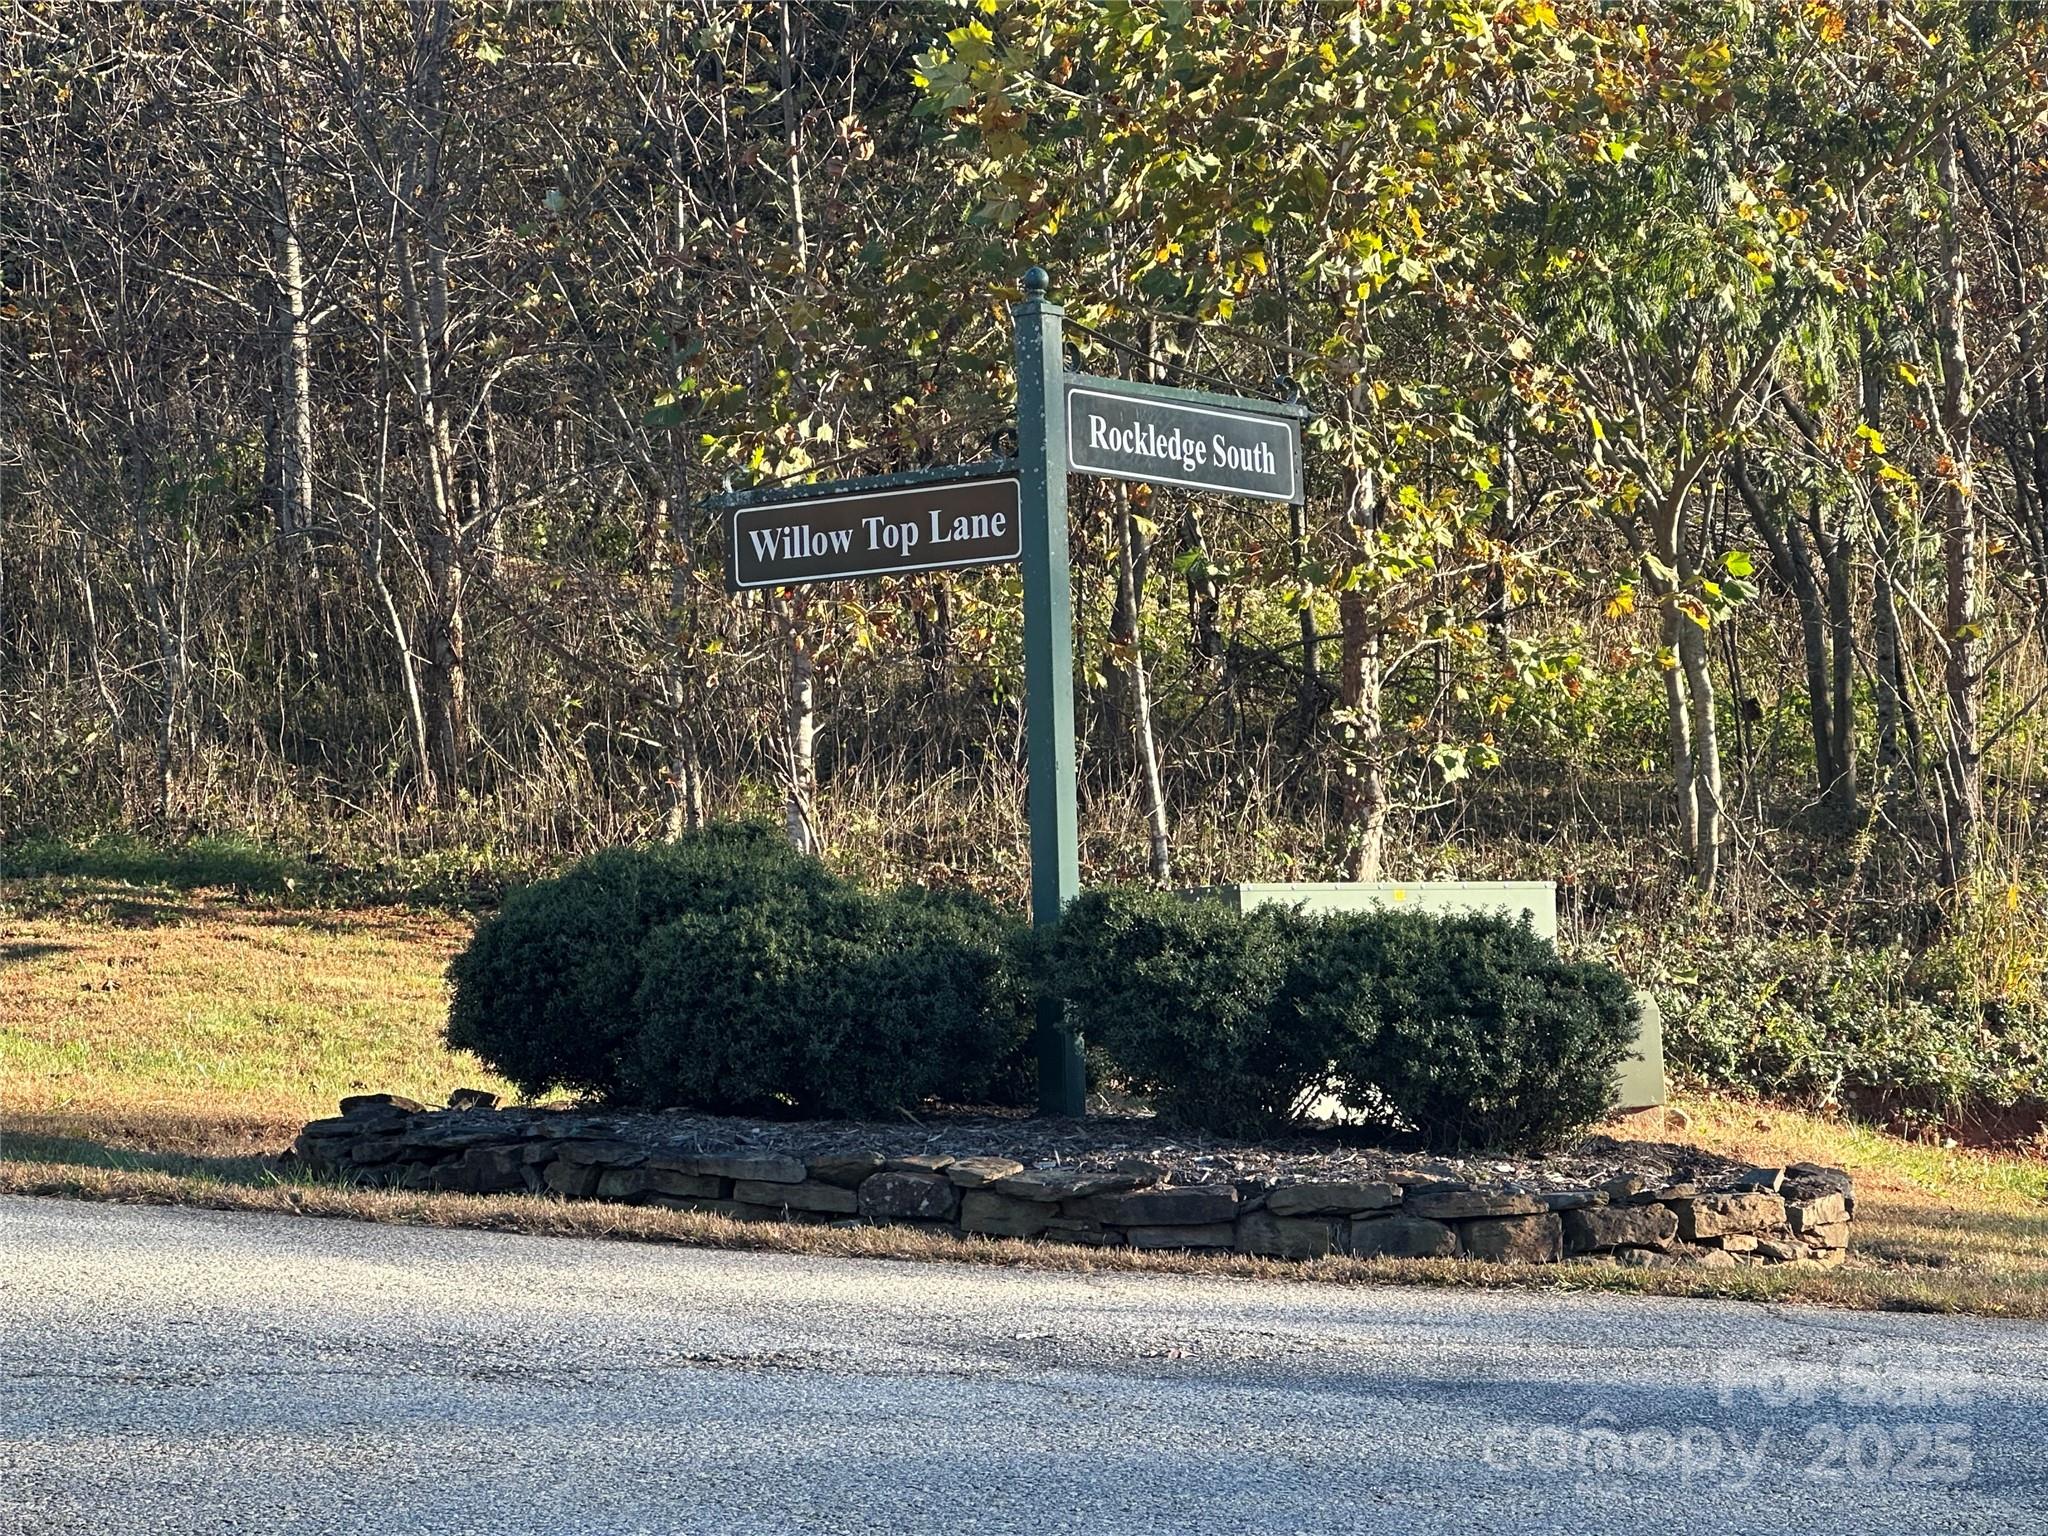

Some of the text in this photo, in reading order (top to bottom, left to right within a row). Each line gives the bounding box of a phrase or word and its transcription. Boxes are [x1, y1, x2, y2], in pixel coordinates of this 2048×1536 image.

[1088, 414, 1277, 475] Rockledge South
[749, 509, 1007, 562] Willow Top Lane
